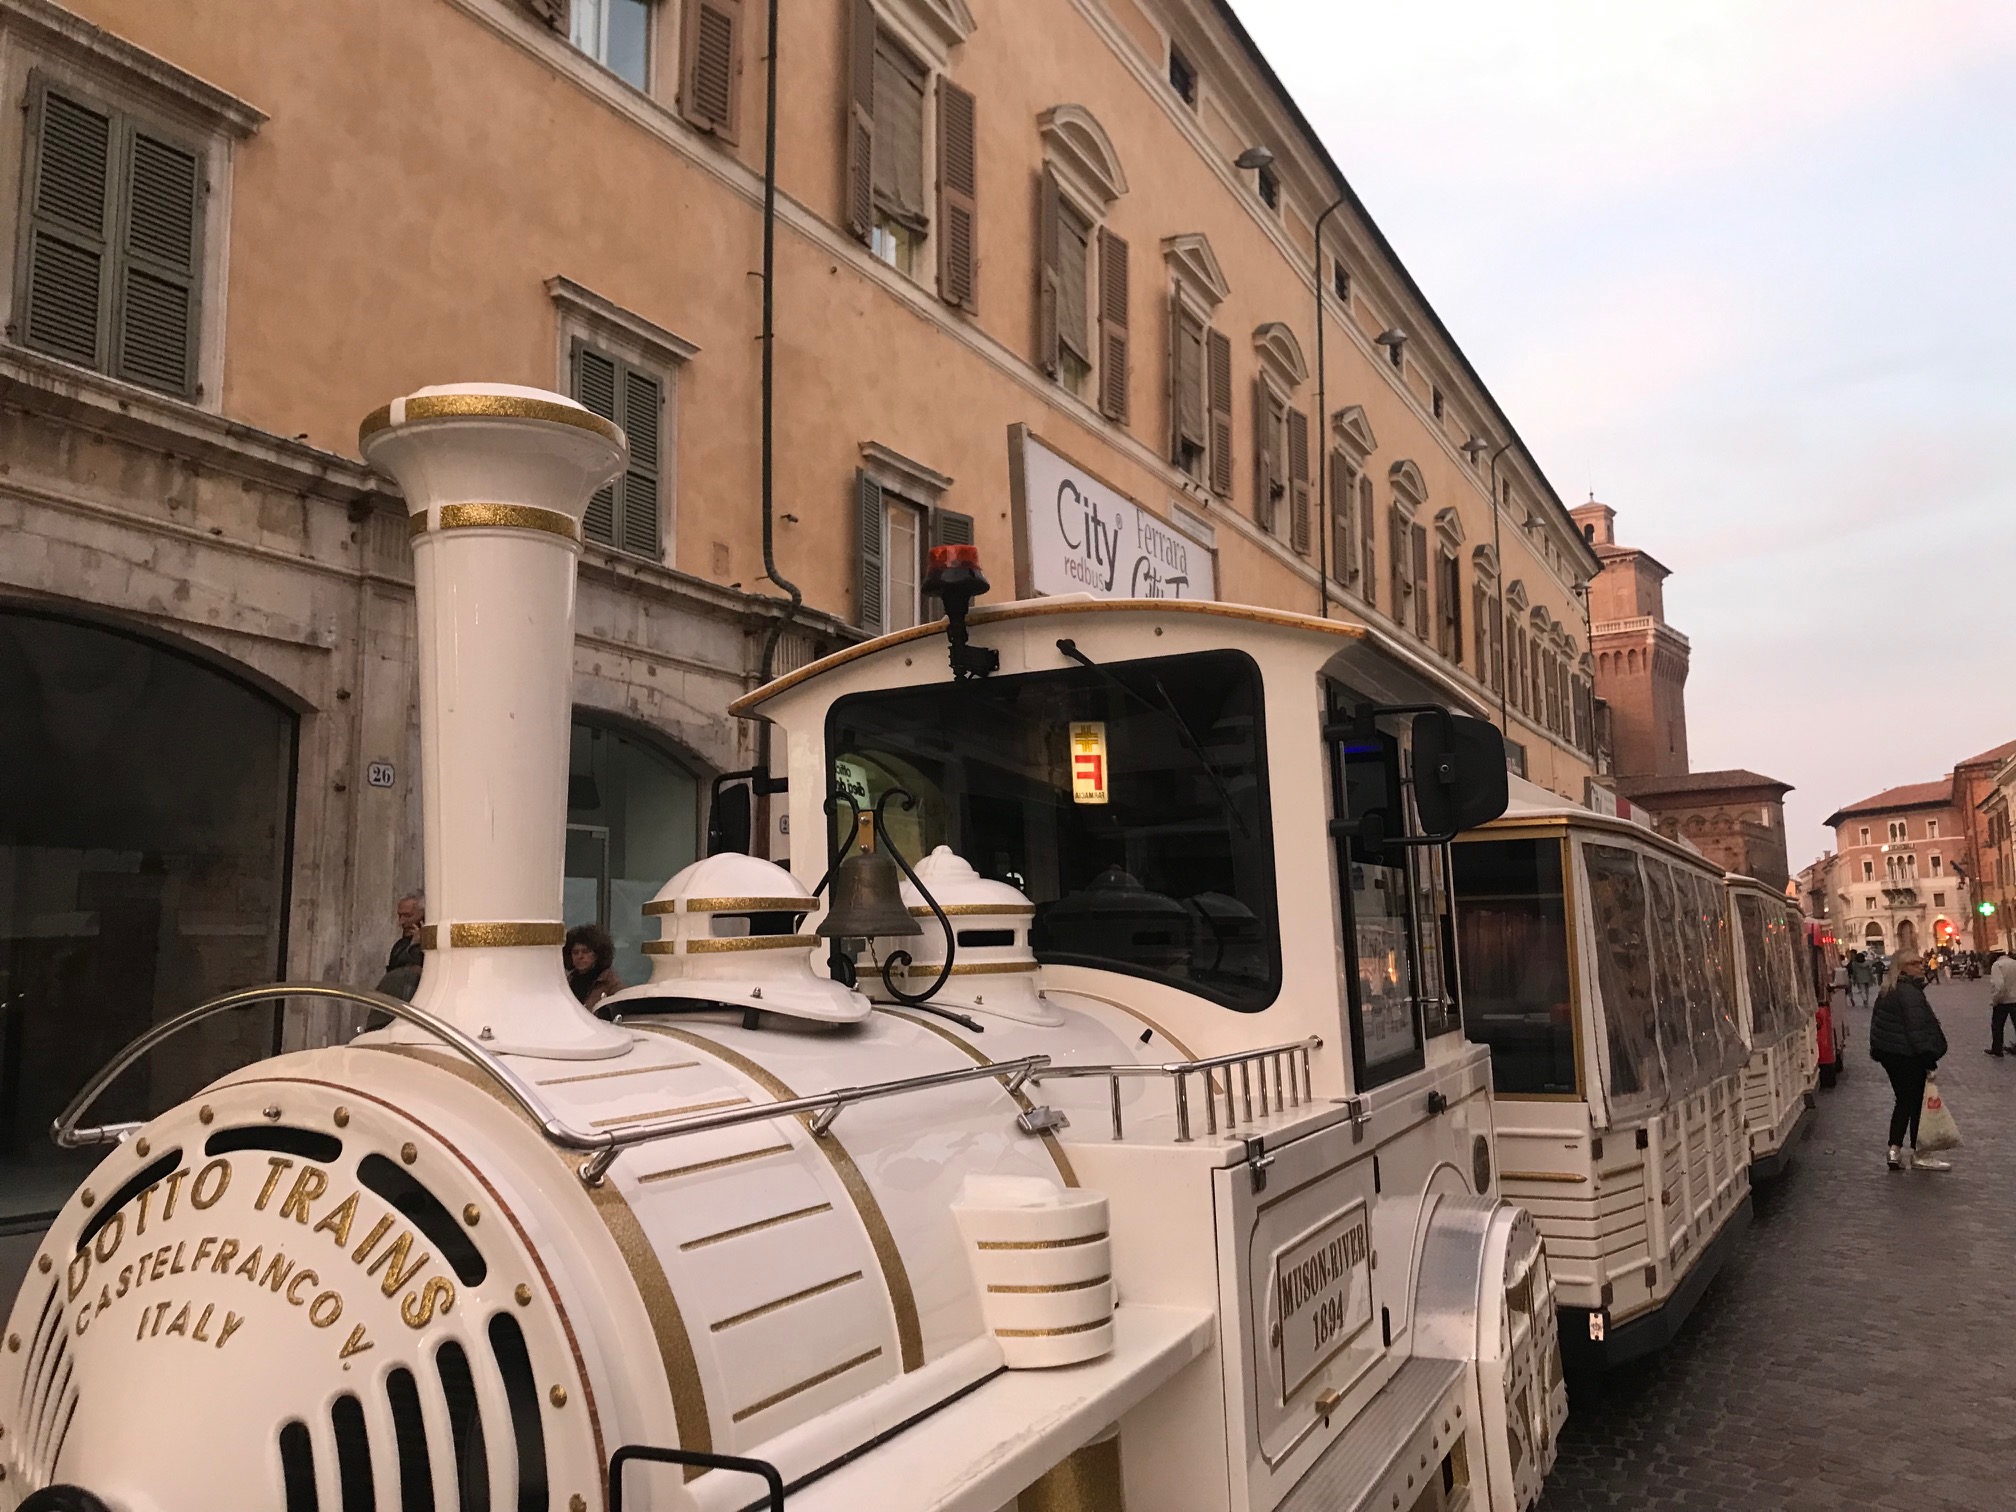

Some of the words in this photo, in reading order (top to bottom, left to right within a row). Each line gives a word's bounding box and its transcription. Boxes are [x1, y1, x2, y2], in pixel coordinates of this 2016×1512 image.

[1057, 479, 1118, 592] City
[1136, 508, 1188, 576] Ferrara
[1064, 555, 1105, 592] redbus
[373, 766, 391, 783] 26
[67, 1157, 233, 1304] DOTTO
[254, 1156, 456, 1330] TRAINS
[75, 1236, 344, 1337] CASTELFRANCO
[136, 1299, 246, 1349] ITALY
[1312, 1289, 1344, 1352] 1894
